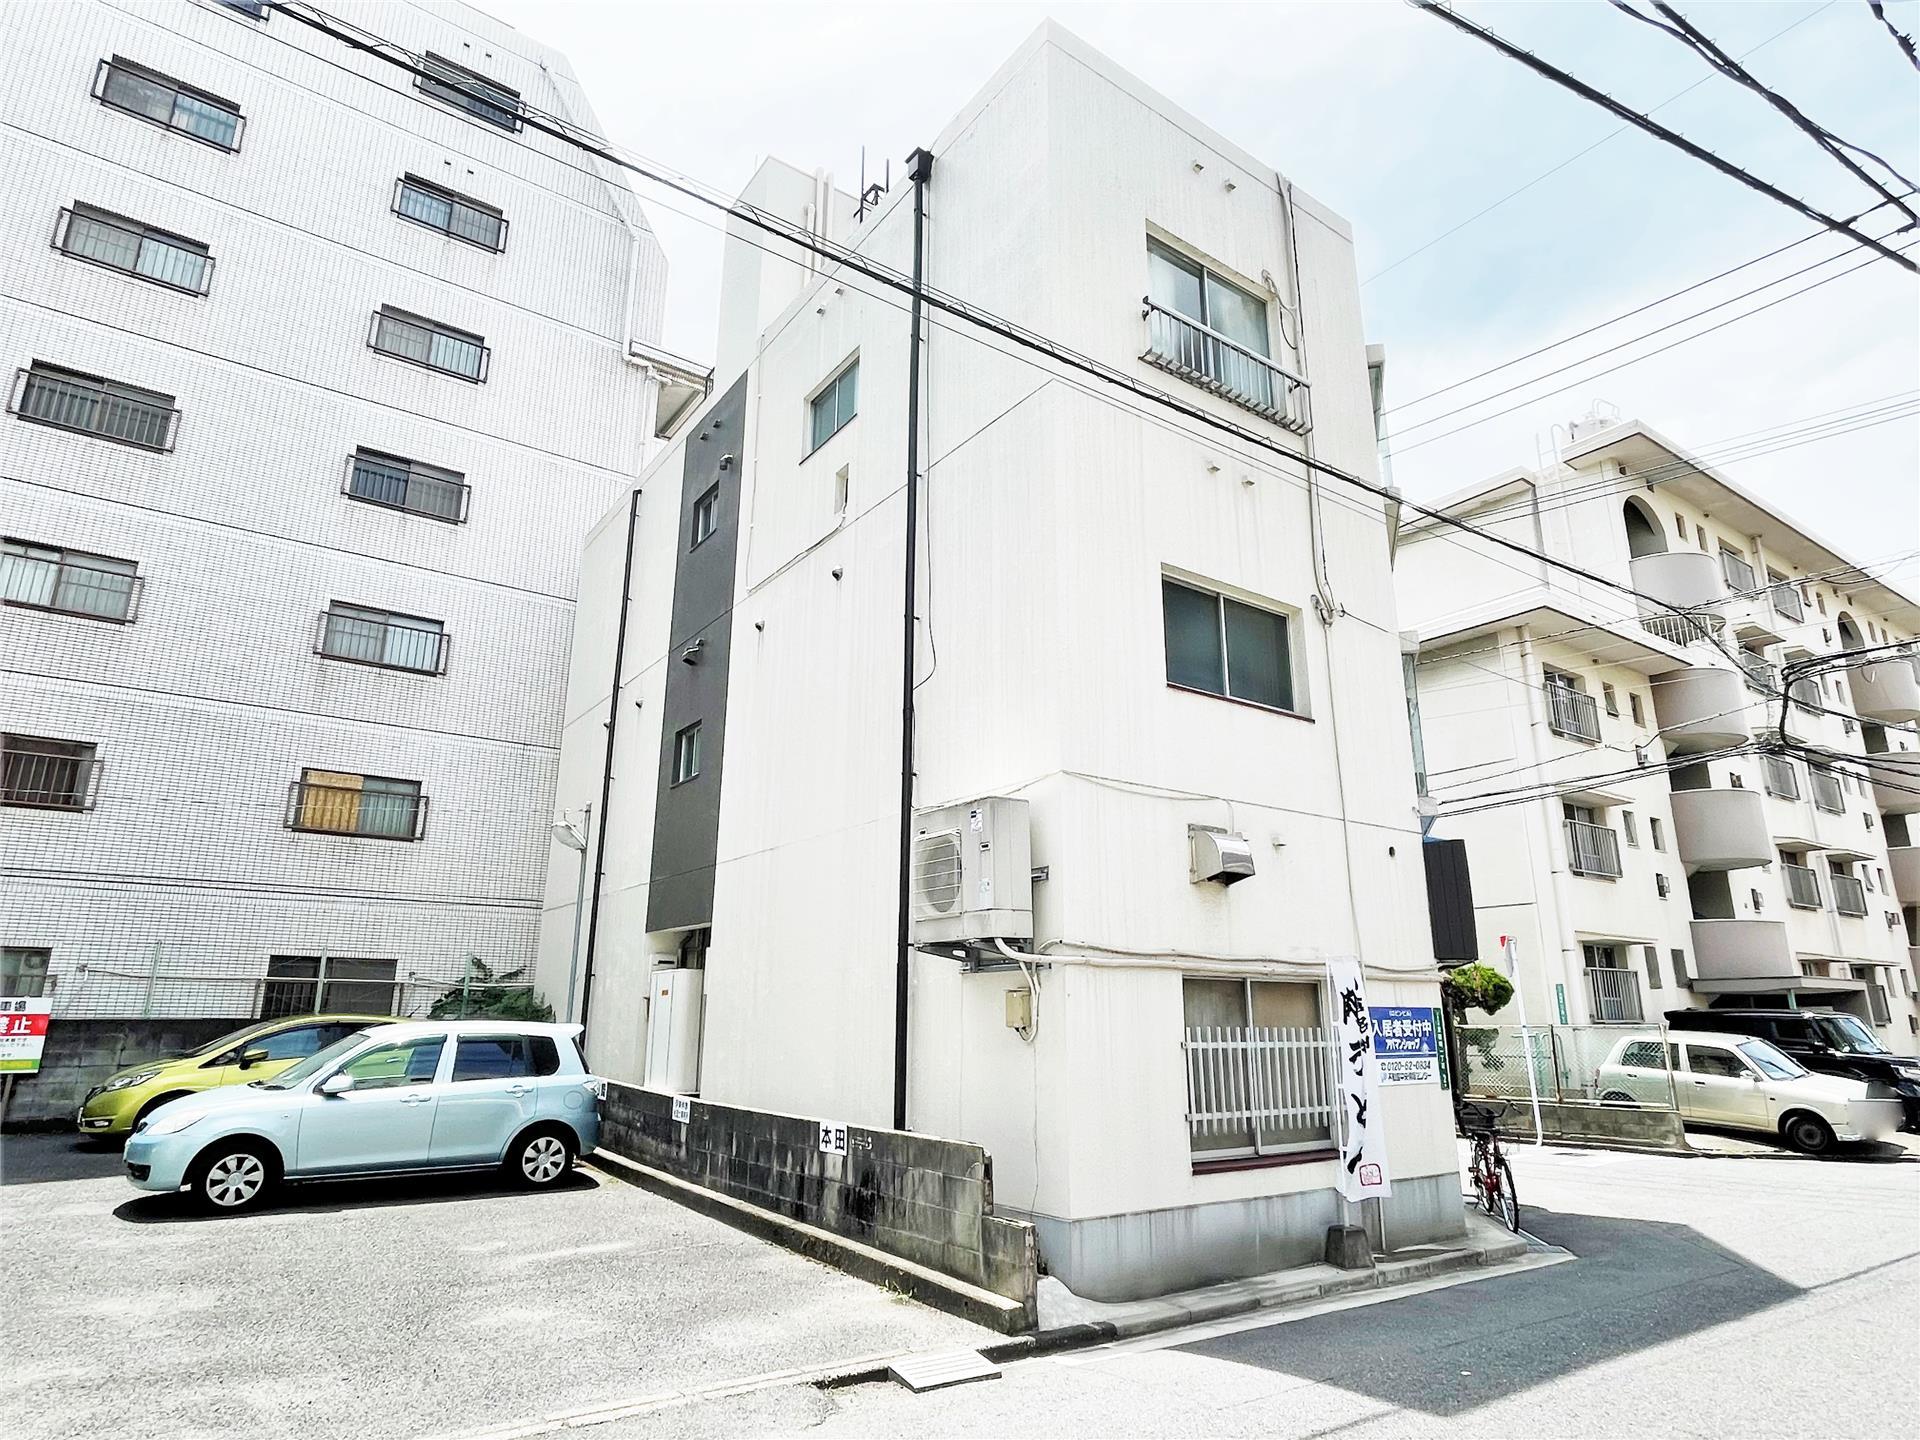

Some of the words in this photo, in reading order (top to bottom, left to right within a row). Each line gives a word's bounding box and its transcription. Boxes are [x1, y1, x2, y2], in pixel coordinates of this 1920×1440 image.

[1371, 1019, 1432, 1038] 入居者受付中
[1385, 1038, 1421, 1050] アパマンショップ
[821, 1125, 845, 1151] 本田
